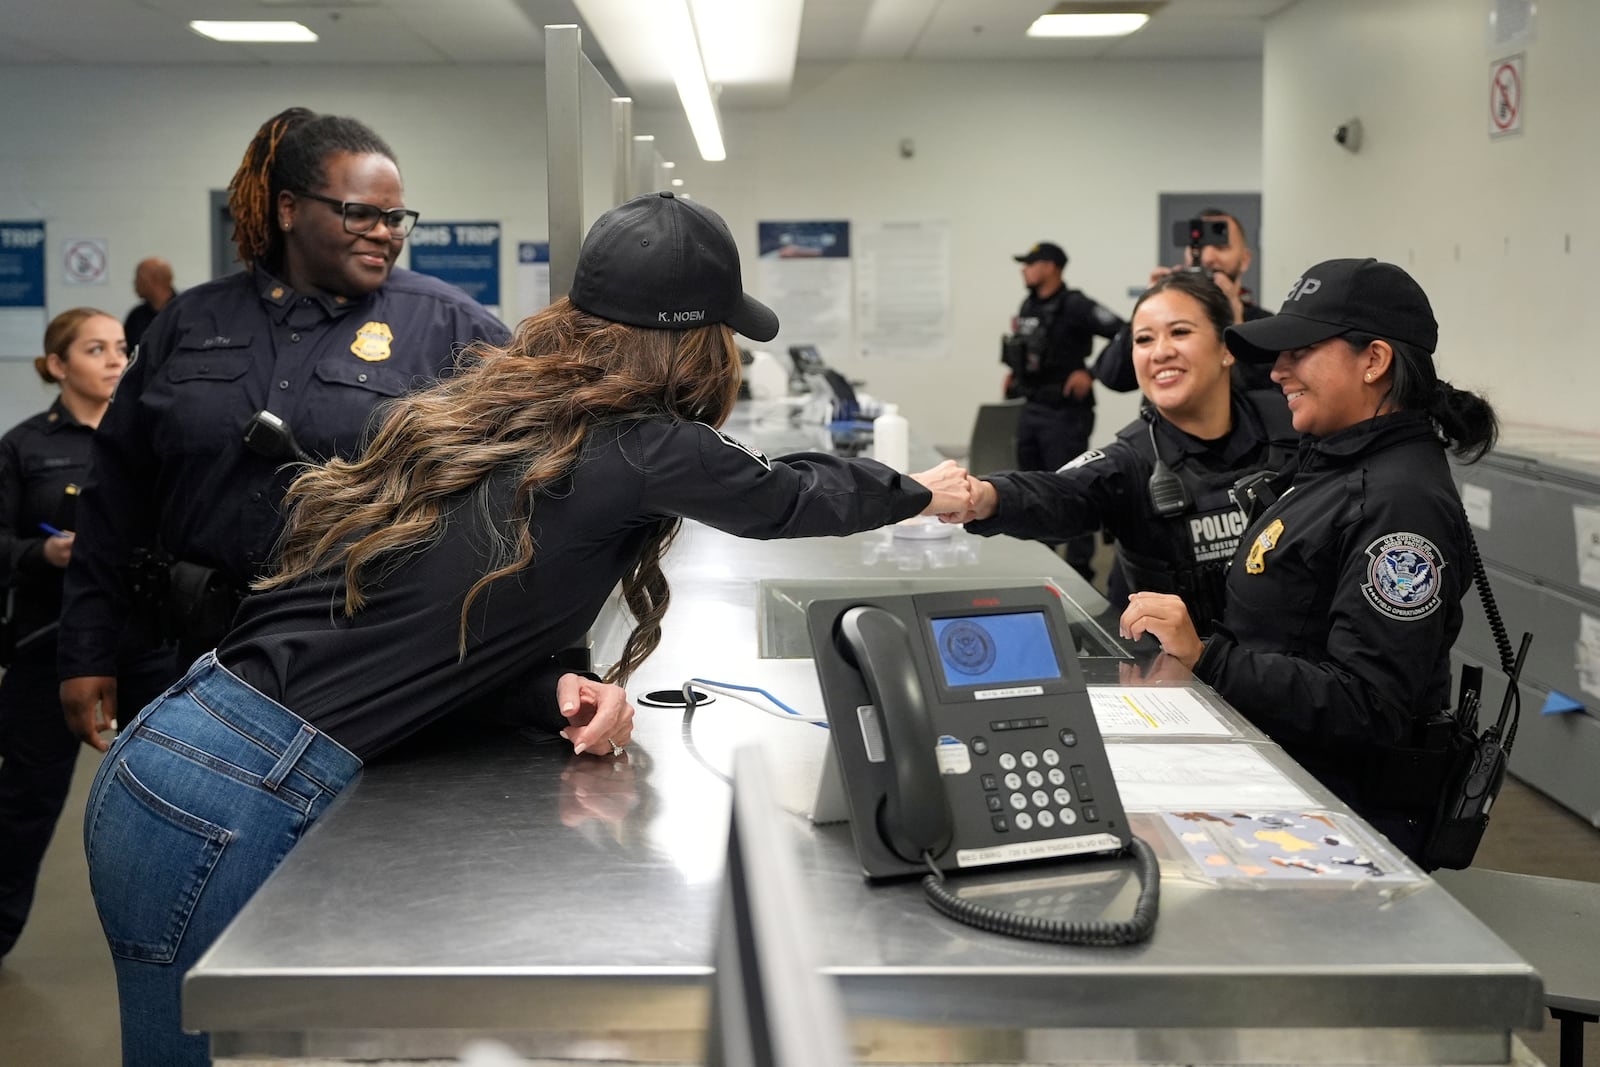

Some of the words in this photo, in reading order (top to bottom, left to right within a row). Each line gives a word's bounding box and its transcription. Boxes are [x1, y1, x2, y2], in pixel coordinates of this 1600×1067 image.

[1, 228, 45, 248] TRIP
[454, 225, 500, 246] TRIP
[658, 311, 670, 322] K.
[673, 310, 705, 322] NOEM
[1209, 538, 1240, 551] CUSTOM
[1396, 535, 1425, 546] CUSTOMS
[1380, 541, 1402, 552] BORDER
[1403, 541, 1435, 559] PROTECTION
[1377, 599, 1391, 611] FIELD
[1392, 608, 1426, 616] OPERATIONS
